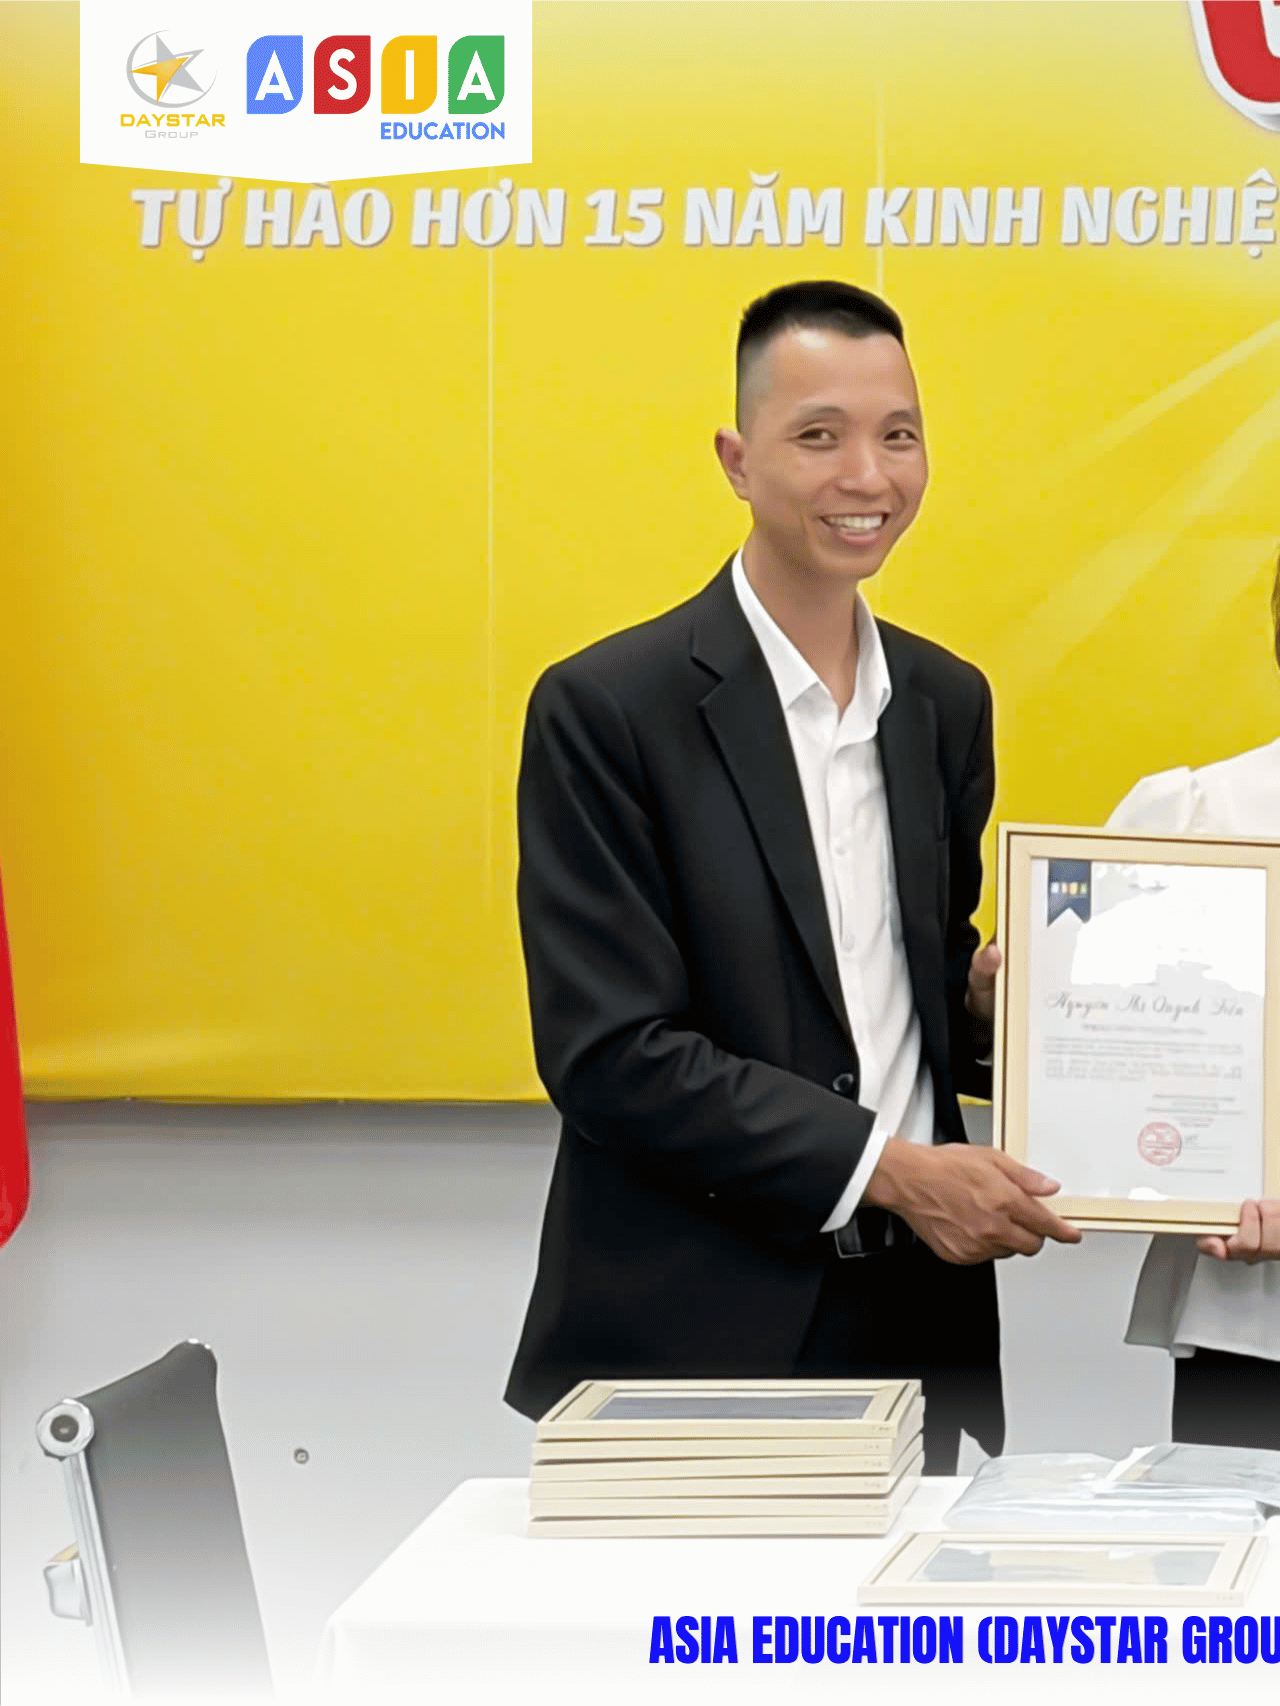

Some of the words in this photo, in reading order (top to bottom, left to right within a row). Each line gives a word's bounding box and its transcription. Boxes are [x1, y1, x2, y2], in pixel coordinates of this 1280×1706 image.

[132, 177, 234, 262] TỰ
[410, 178, 566, 248] HƠN
[584, 187, 664, 248] 15
[684, 171, 844, 246] NĂM
[864, 187, 1042, 246] KINH
